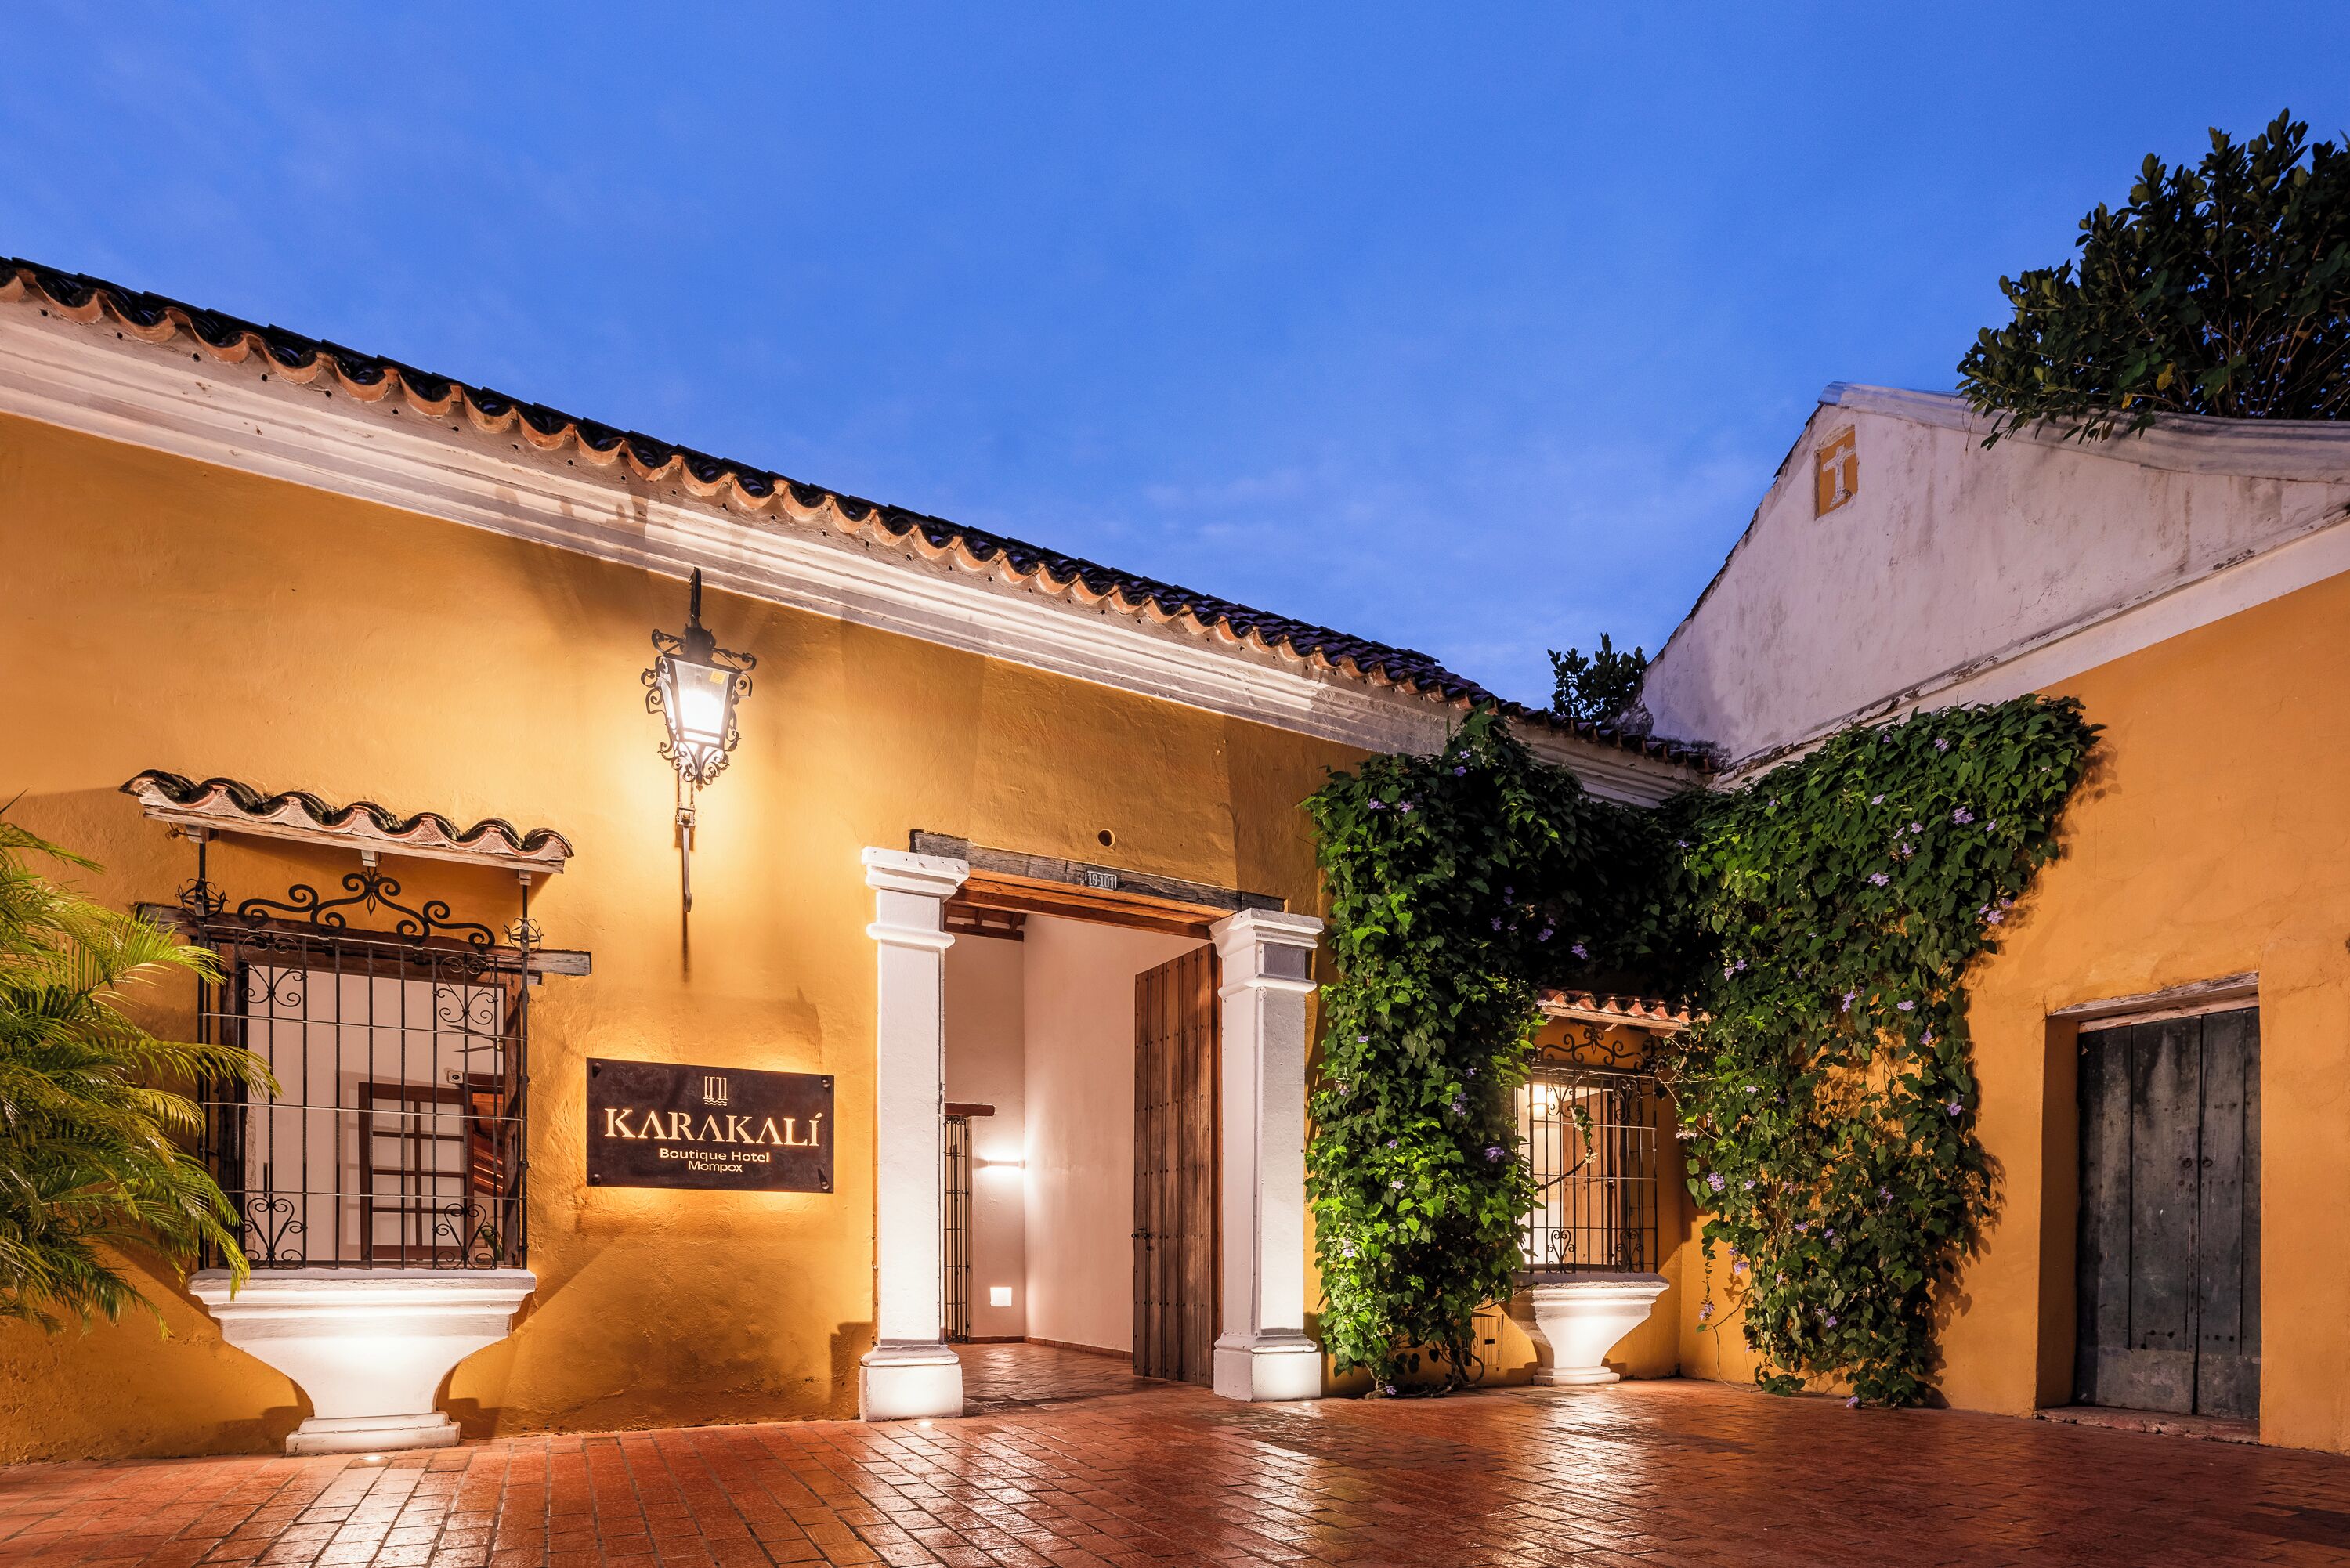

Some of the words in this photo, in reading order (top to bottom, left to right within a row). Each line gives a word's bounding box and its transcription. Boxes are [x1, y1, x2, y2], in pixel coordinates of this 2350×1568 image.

[604, 1108, 822, 1146] KARAKALÍ
[660, 1148, 727, 1162] Boutique
[731, 1151, 770, 1163] Hotel
[688, 1160, 743, 1173] Mompox
